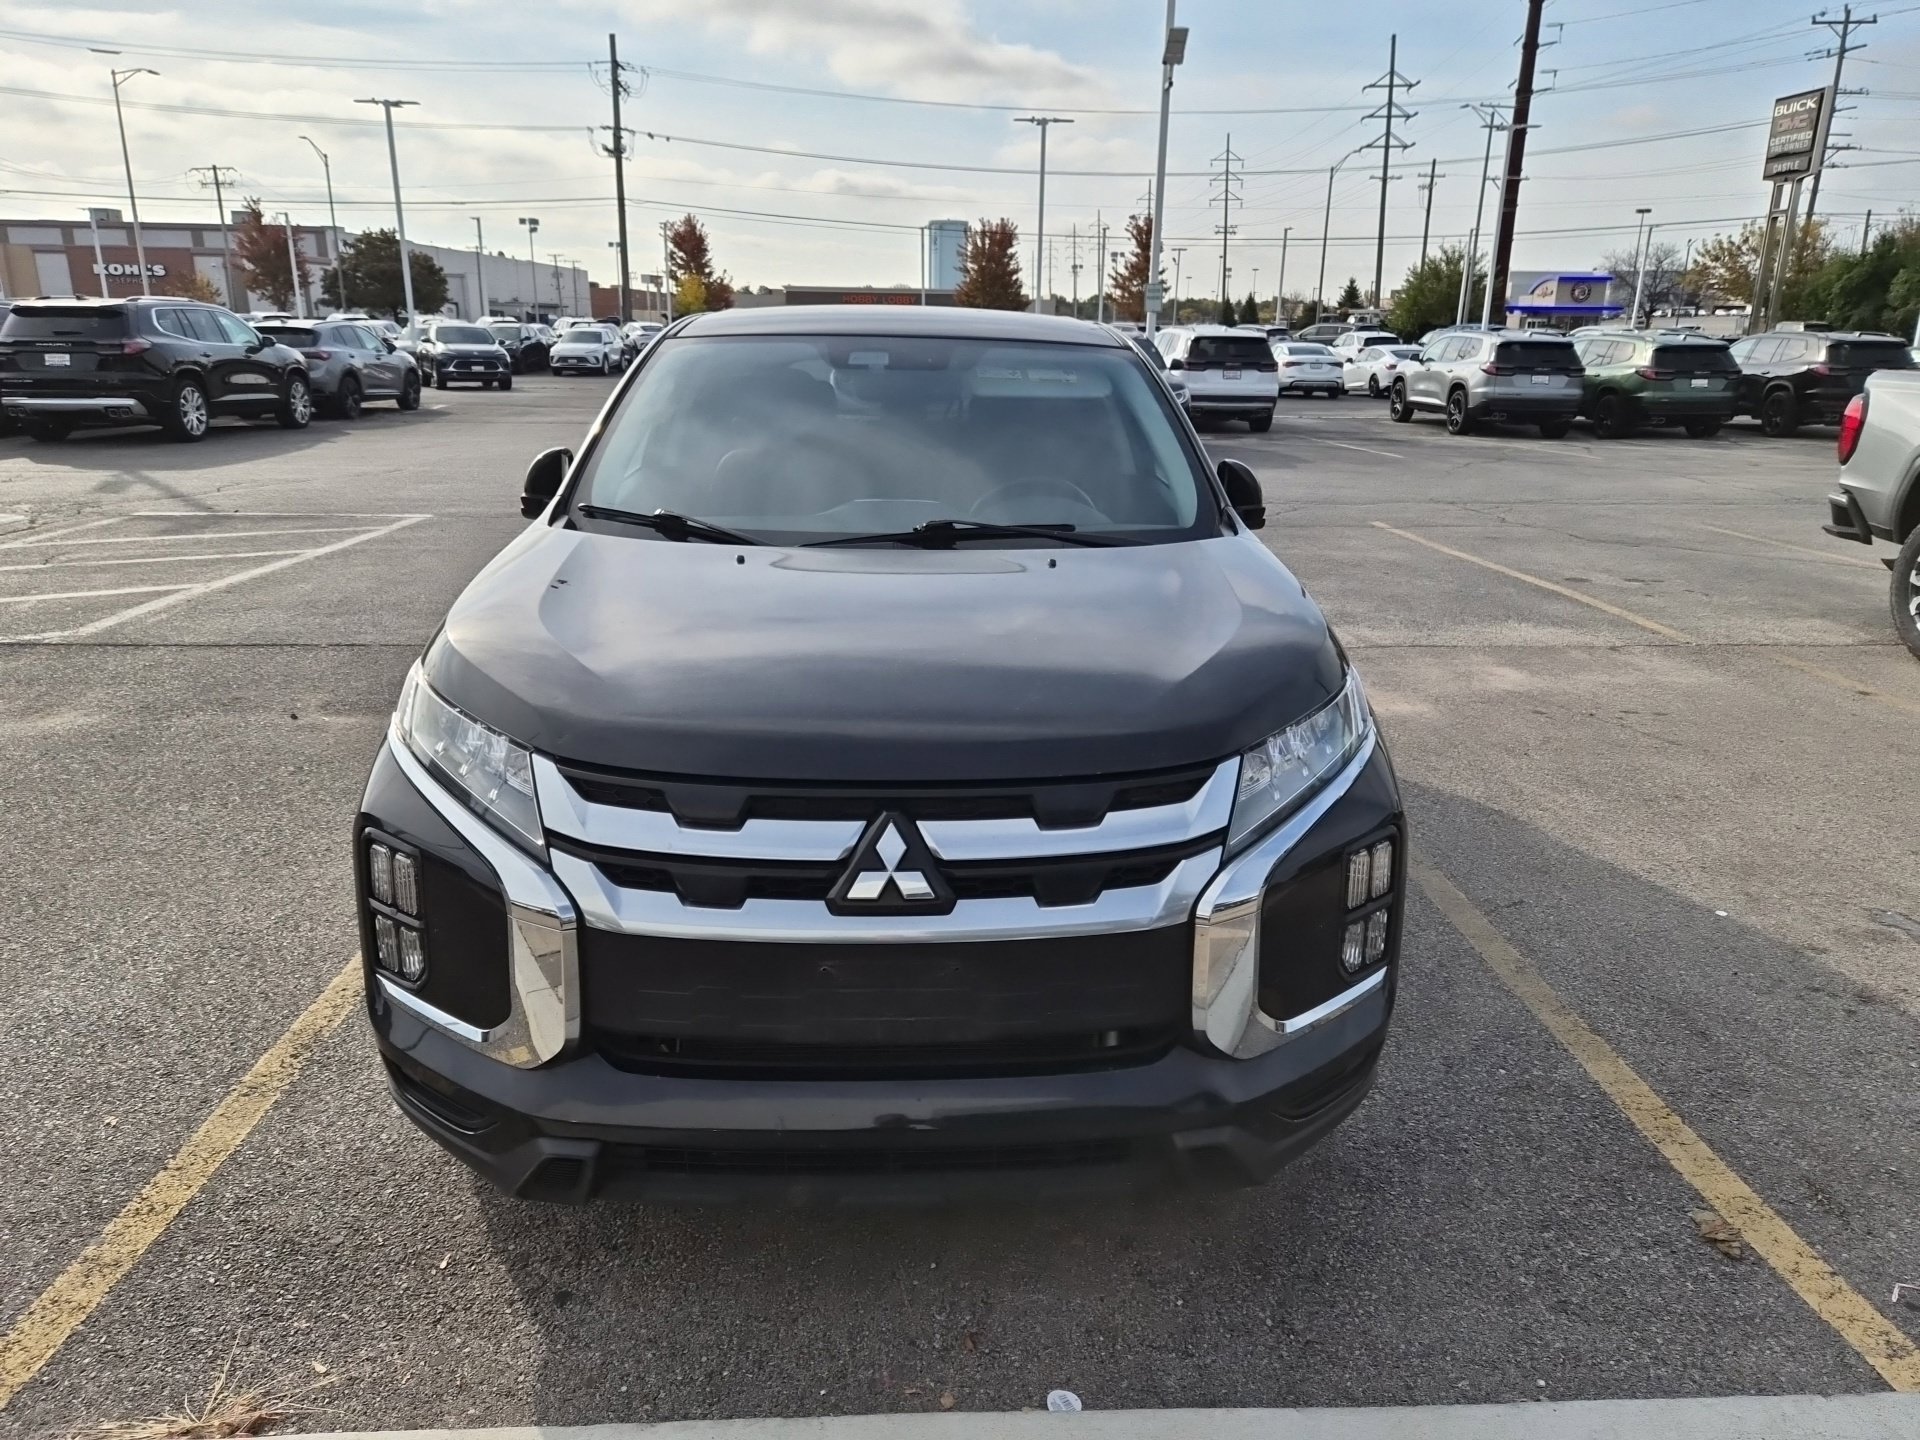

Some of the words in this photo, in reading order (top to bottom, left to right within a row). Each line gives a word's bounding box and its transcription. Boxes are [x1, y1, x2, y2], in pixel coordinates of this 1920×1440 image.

[1775, 97, 1818, 117] BUICK
[1777, 114, 1809, 132] GMC
[1770, 131, 1813, 147] CERTIFIED
[1773, 161, 1800, 174] CASTLE
[842, 294, 879, 304] HOBBY
[882, 295, 917, 305] LOBBY
